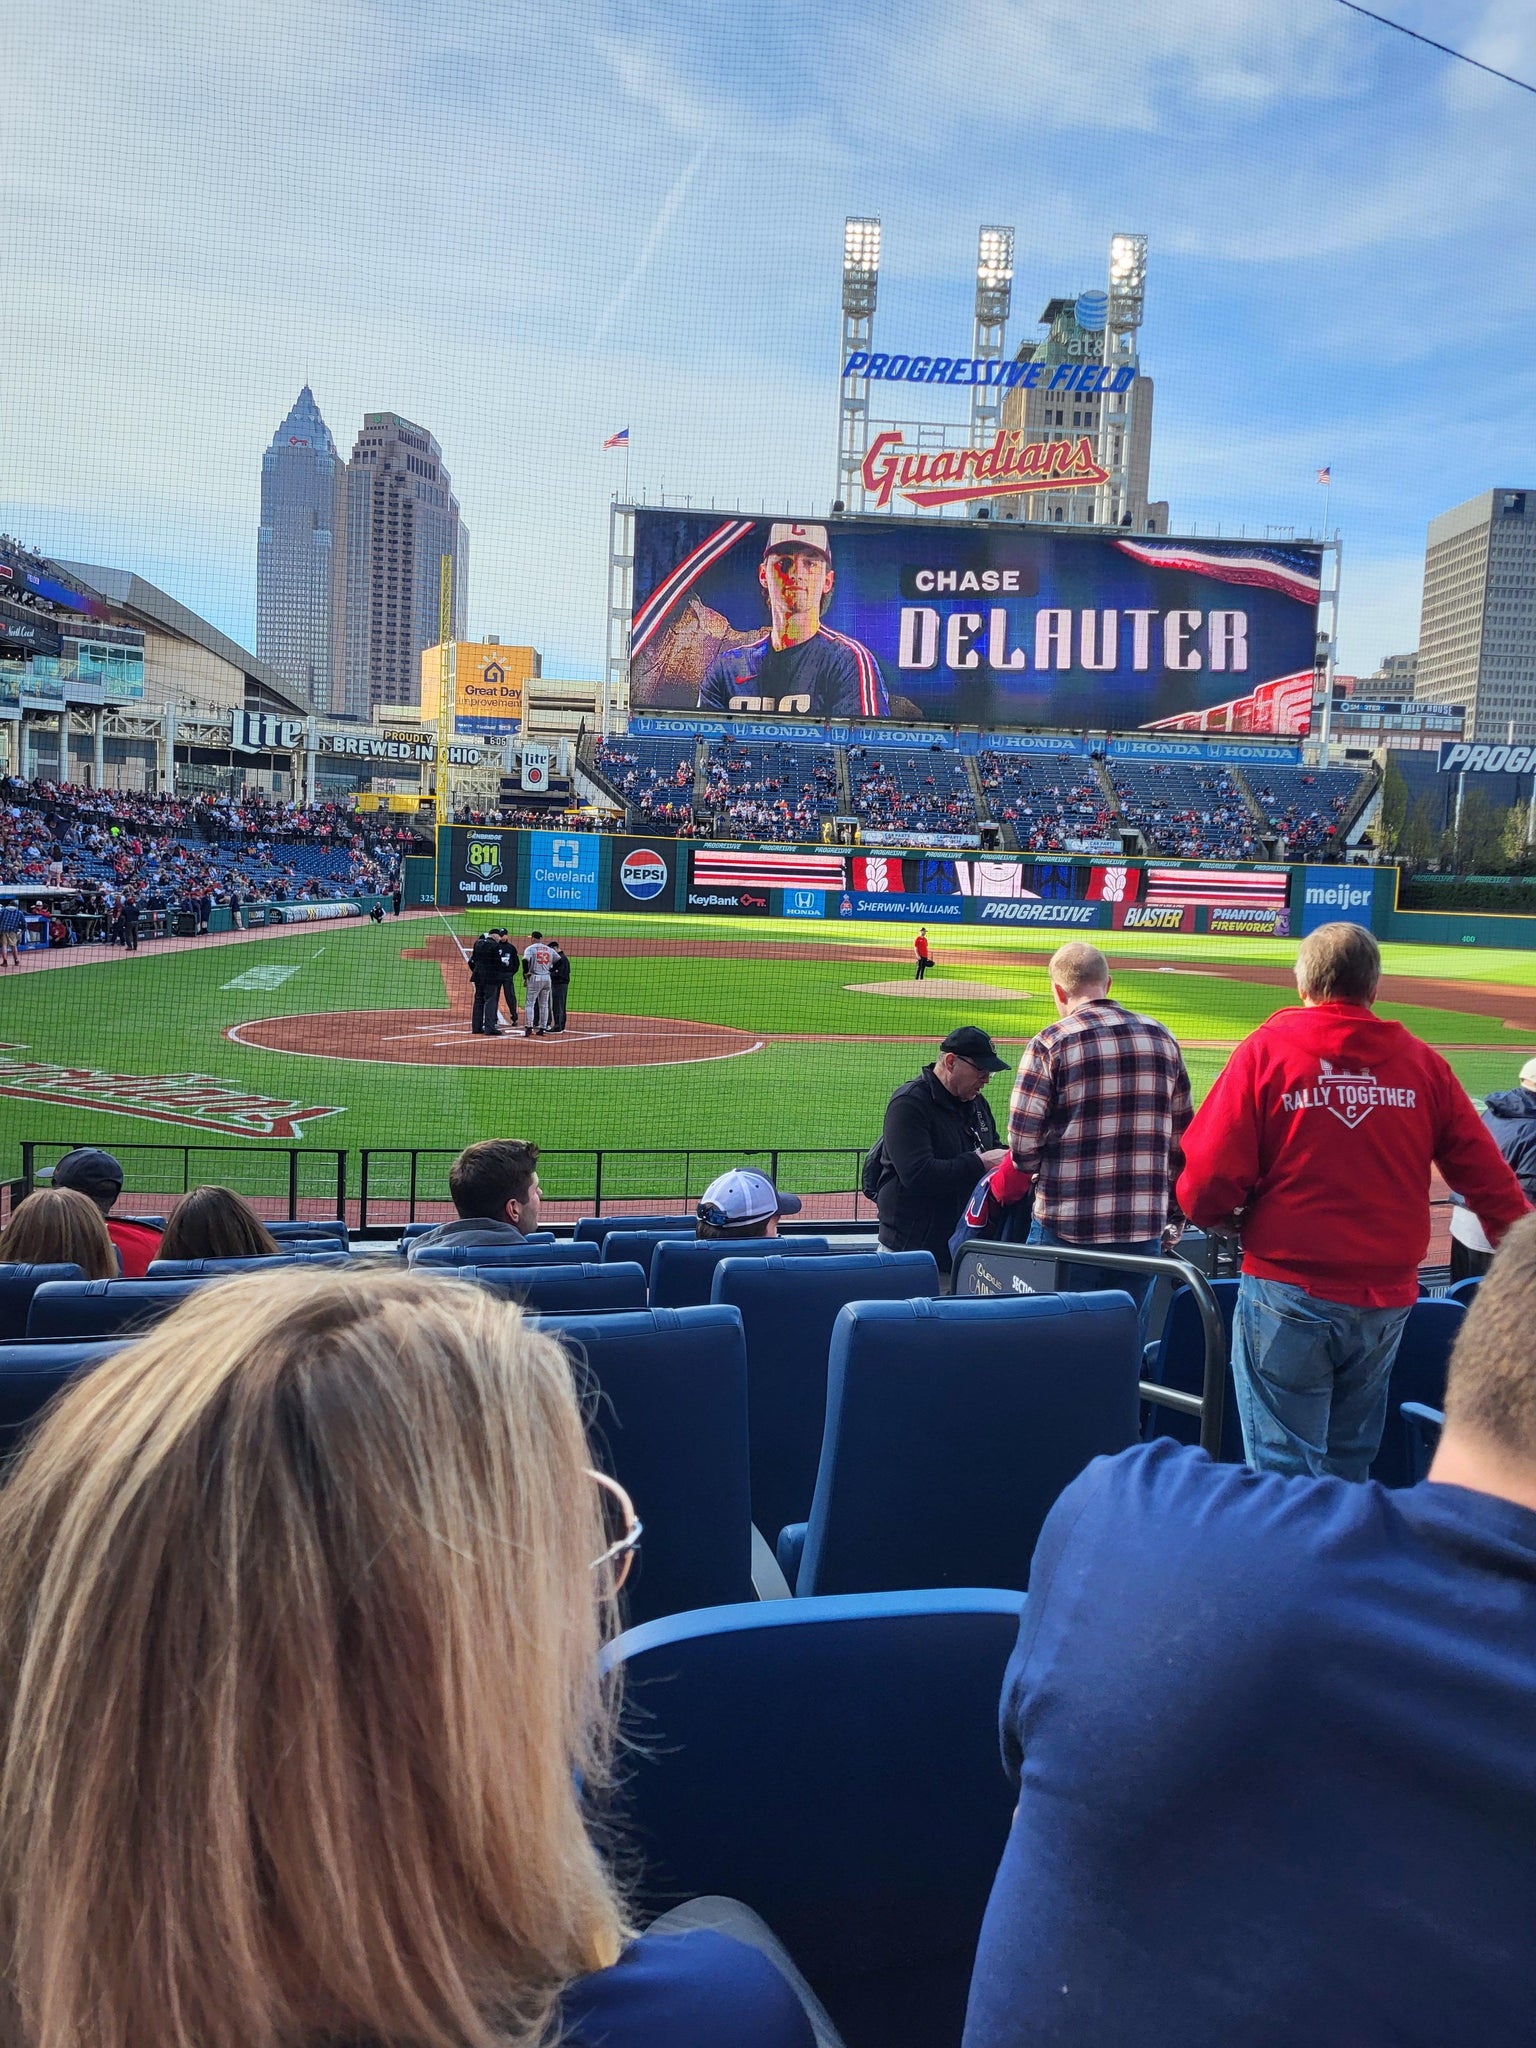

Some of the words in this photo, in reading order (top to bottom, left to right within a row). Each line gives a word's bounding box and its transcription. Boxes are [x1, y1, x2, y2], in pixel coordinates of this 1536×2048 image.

[843, 352, 1045, 390] PROGRESSIVE
[1048, 363, 1136, 394] FIELD
[861, 429, 1110, 510] Guardians
[915, 569, 1020, 591] CHASE
[465, 685, 498, 697] Great
[500, 686, 522, 699] Day
[1401, 704, 1425, 715] RALLY
[1427, 705, 1453, 716] HOUSE
[228, 707, 303, 755] Lite
[655, 720, 728, 735] HONDA
[750, 725, 823, 738] HONDA
[384, 730, 433, 744] PROUDLY
[877, 730, 949, 744] HONDA
[1006, 736, 1076, 749] HONDA
[333, 735, 412, 760] BREWED
[414, 744, 435, 761] IN
[1131, 742, 1202, 755] HONDA
[1224, 746, 1295, 759] HONDA
[525, 752, 547, 767] Lite
[470, 843, 498, 866] 811
[759, 844, 797, 852] PROGRESSIVE
[814, 846, 854, 854] PROGRESSIVE
[869, 849, 908, 857] PROGRESSIVE
[924, 851, 965, 859] PROGRESSIVE
[980, 854, 1019, 862] PROGRESSIVE
[1089, 858, 1128, 866] PROGRESSIVE
[1144, 860, 1182, 868] PROGRESSIVE
[1199, 862, 1237, 870] PROGRESSIVE
[1253, 864, 1292, 872] PROGRESSIVE
[534, 868, 595, 883] Cleveland
[623, 869, 664, 880] PEPSI
[459, 881, 477, 892] Call
[480, 882, 508, 893] before
[546, 886, 582, 900] Clinic
[420, 894, 435, 902] 325
[467, 893, 483, 904] you
[688, 894, 739, 906] KeyBank
[1305, 883, 1372, 911] meijer
[981, 902, 1096, 923] PROGRESSIVE
[1123, 907, 1183, 929] BLASTER
[1212, 908, 1276, 922] PHANTOM
[1210, 920, 1275, 933] FIREWORKS
[1461, 935, 1476, 943] 400
[536, 951, 550, 965] 53
[1281, 1086, 1331, 1112] RALLY
[1336, 1085, 1416, 1108] TOGETHER
[1346, 1105, 1357, 1119] C
[1012, 1274, 1036, 1294] SECTIO
